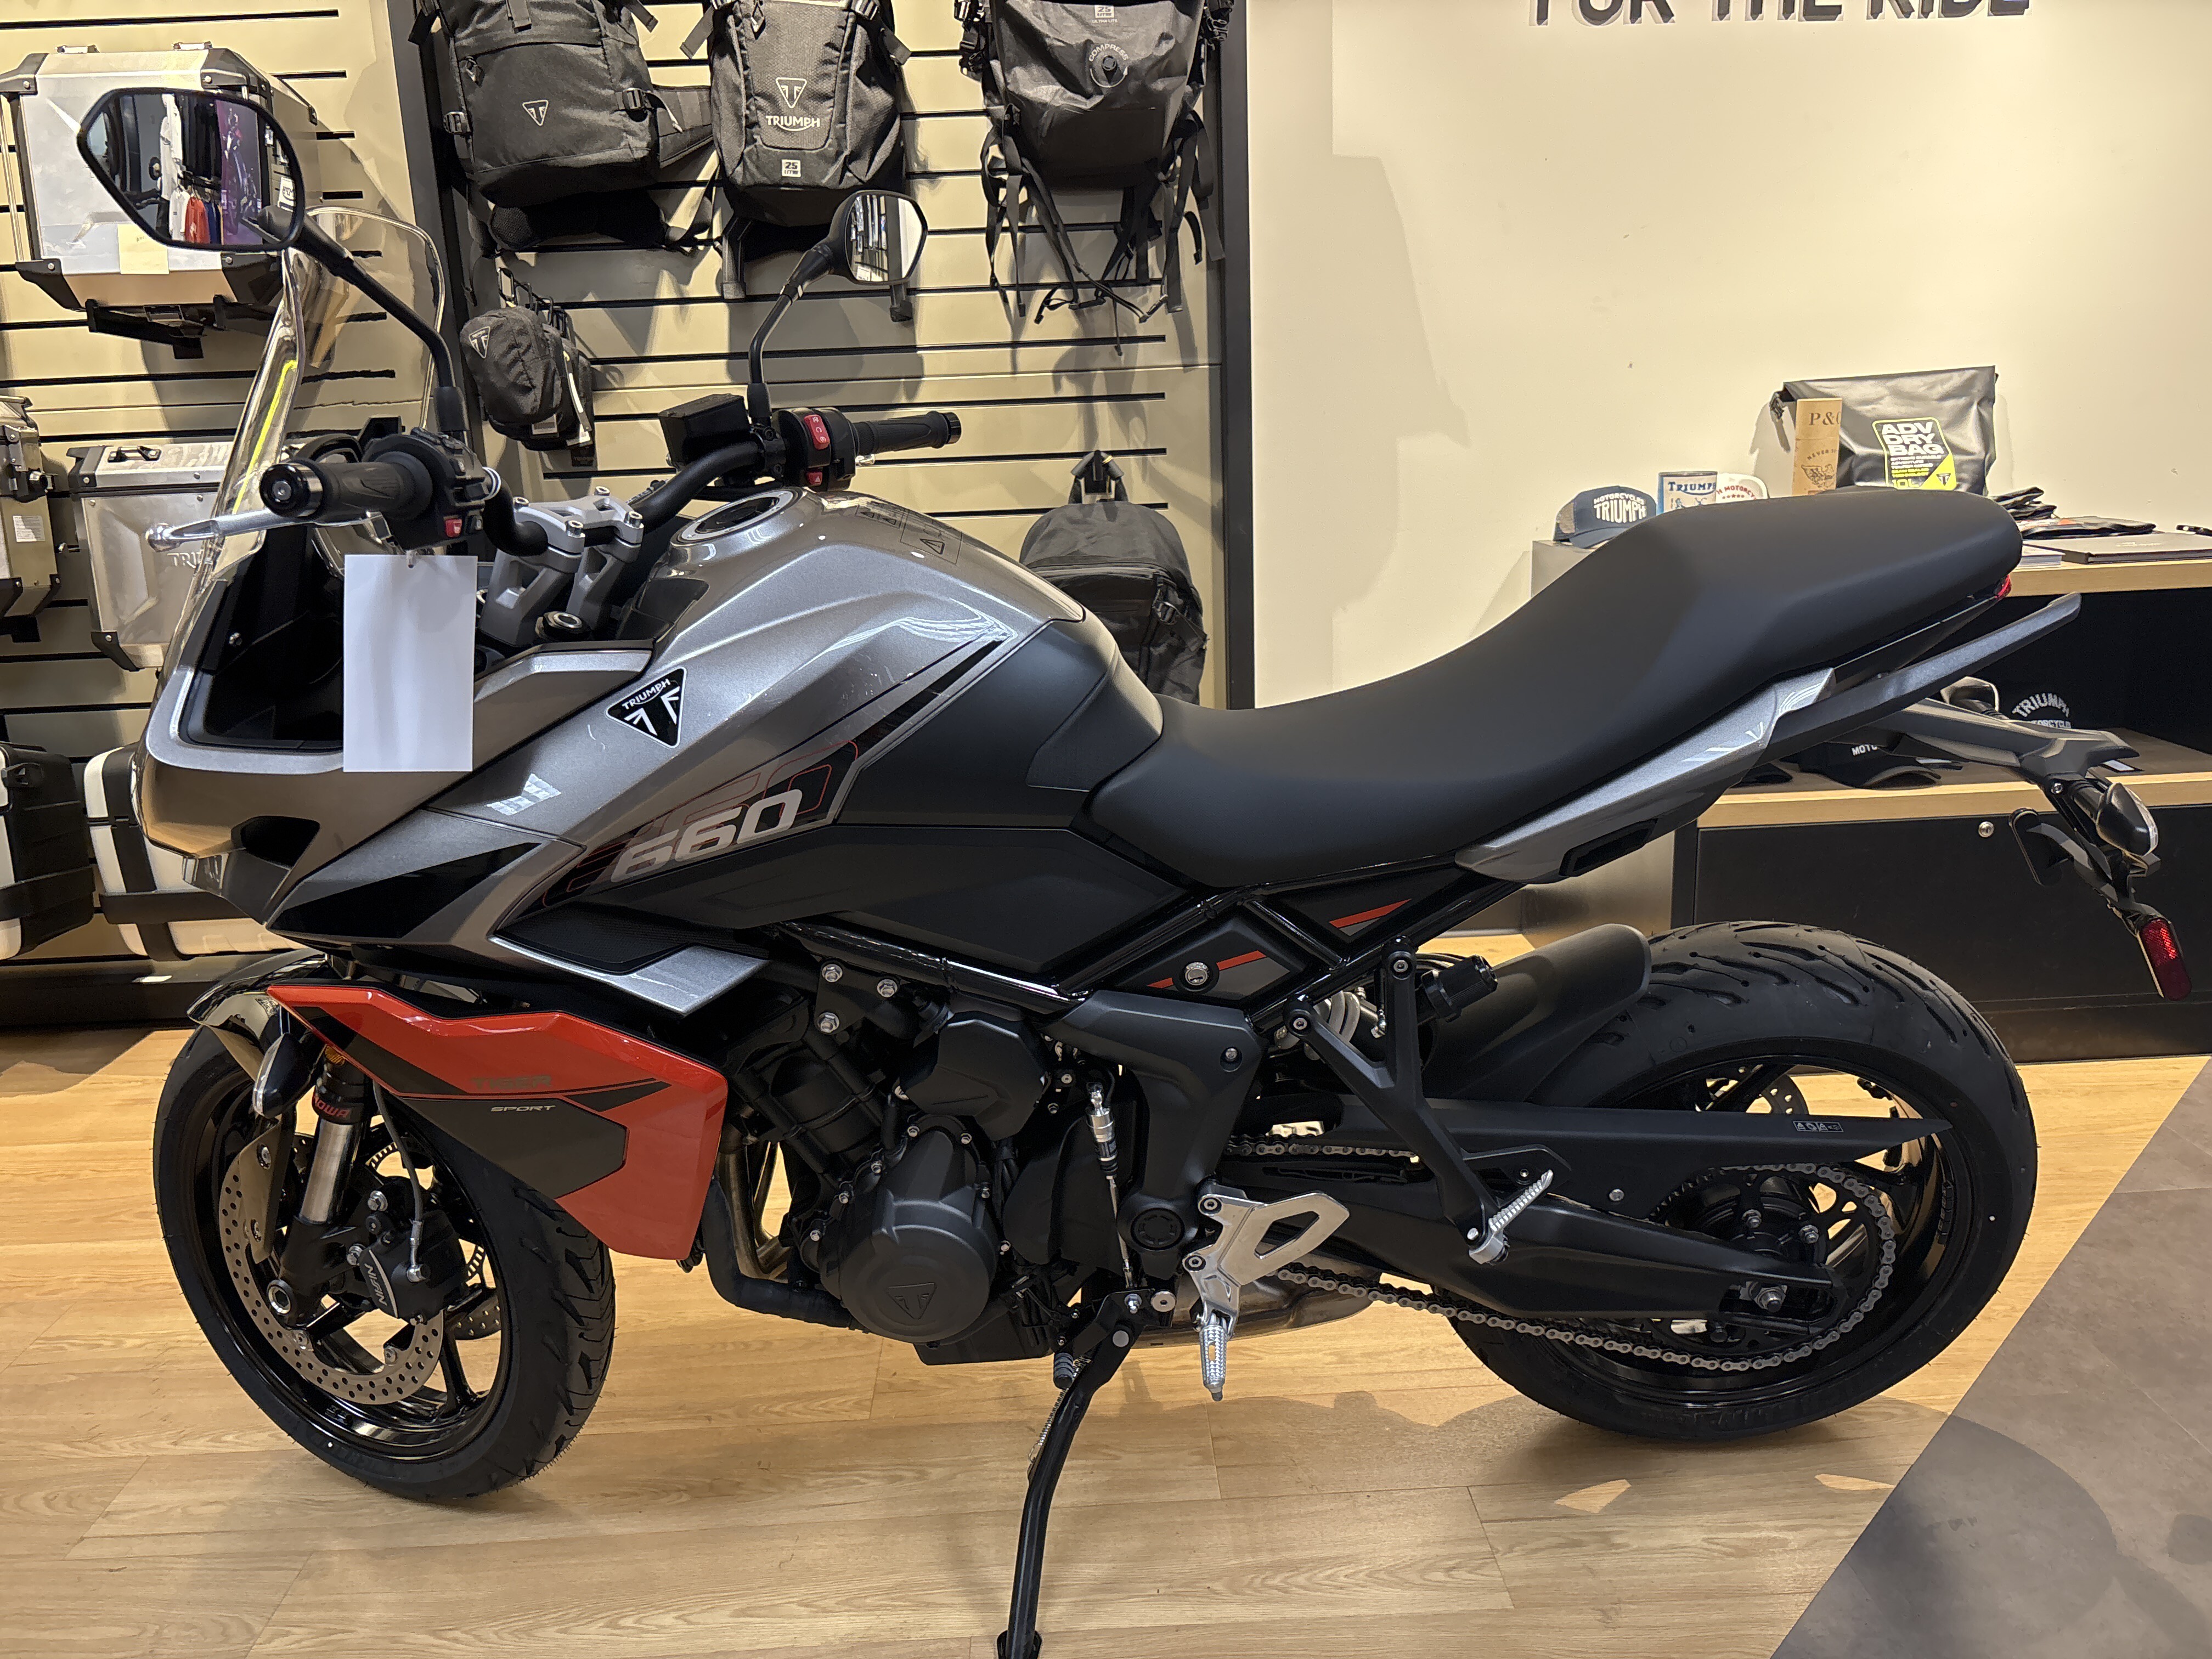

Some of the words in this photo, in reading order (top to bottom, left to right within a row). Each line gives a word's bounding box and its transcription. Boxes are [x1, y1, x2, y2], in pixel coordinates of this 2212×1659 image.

[1088, 44, 1128, 61] COMPRESS
[766, 115, 820, 130] TRIUMPH
[1882, 422, 1933, 435] ADV
[1882, 433, 1935, 444] DRY
[1807, 449, 1829, 460] NEVER
[1888, 443, 1945, 456] BAG
[1892, 478, 1920, 489] 10L
[1724, 485, 1756, 500] MOTORCY
[1594, 499, 1646, 523] TRIUMPH
[622, 678, 671, 710] TRIUMPH
[2012, 693, 2069, 718] TRIUMPH
[611, 789, 803, 883] 660
[471, 1075, 552, 1090] TIGER
